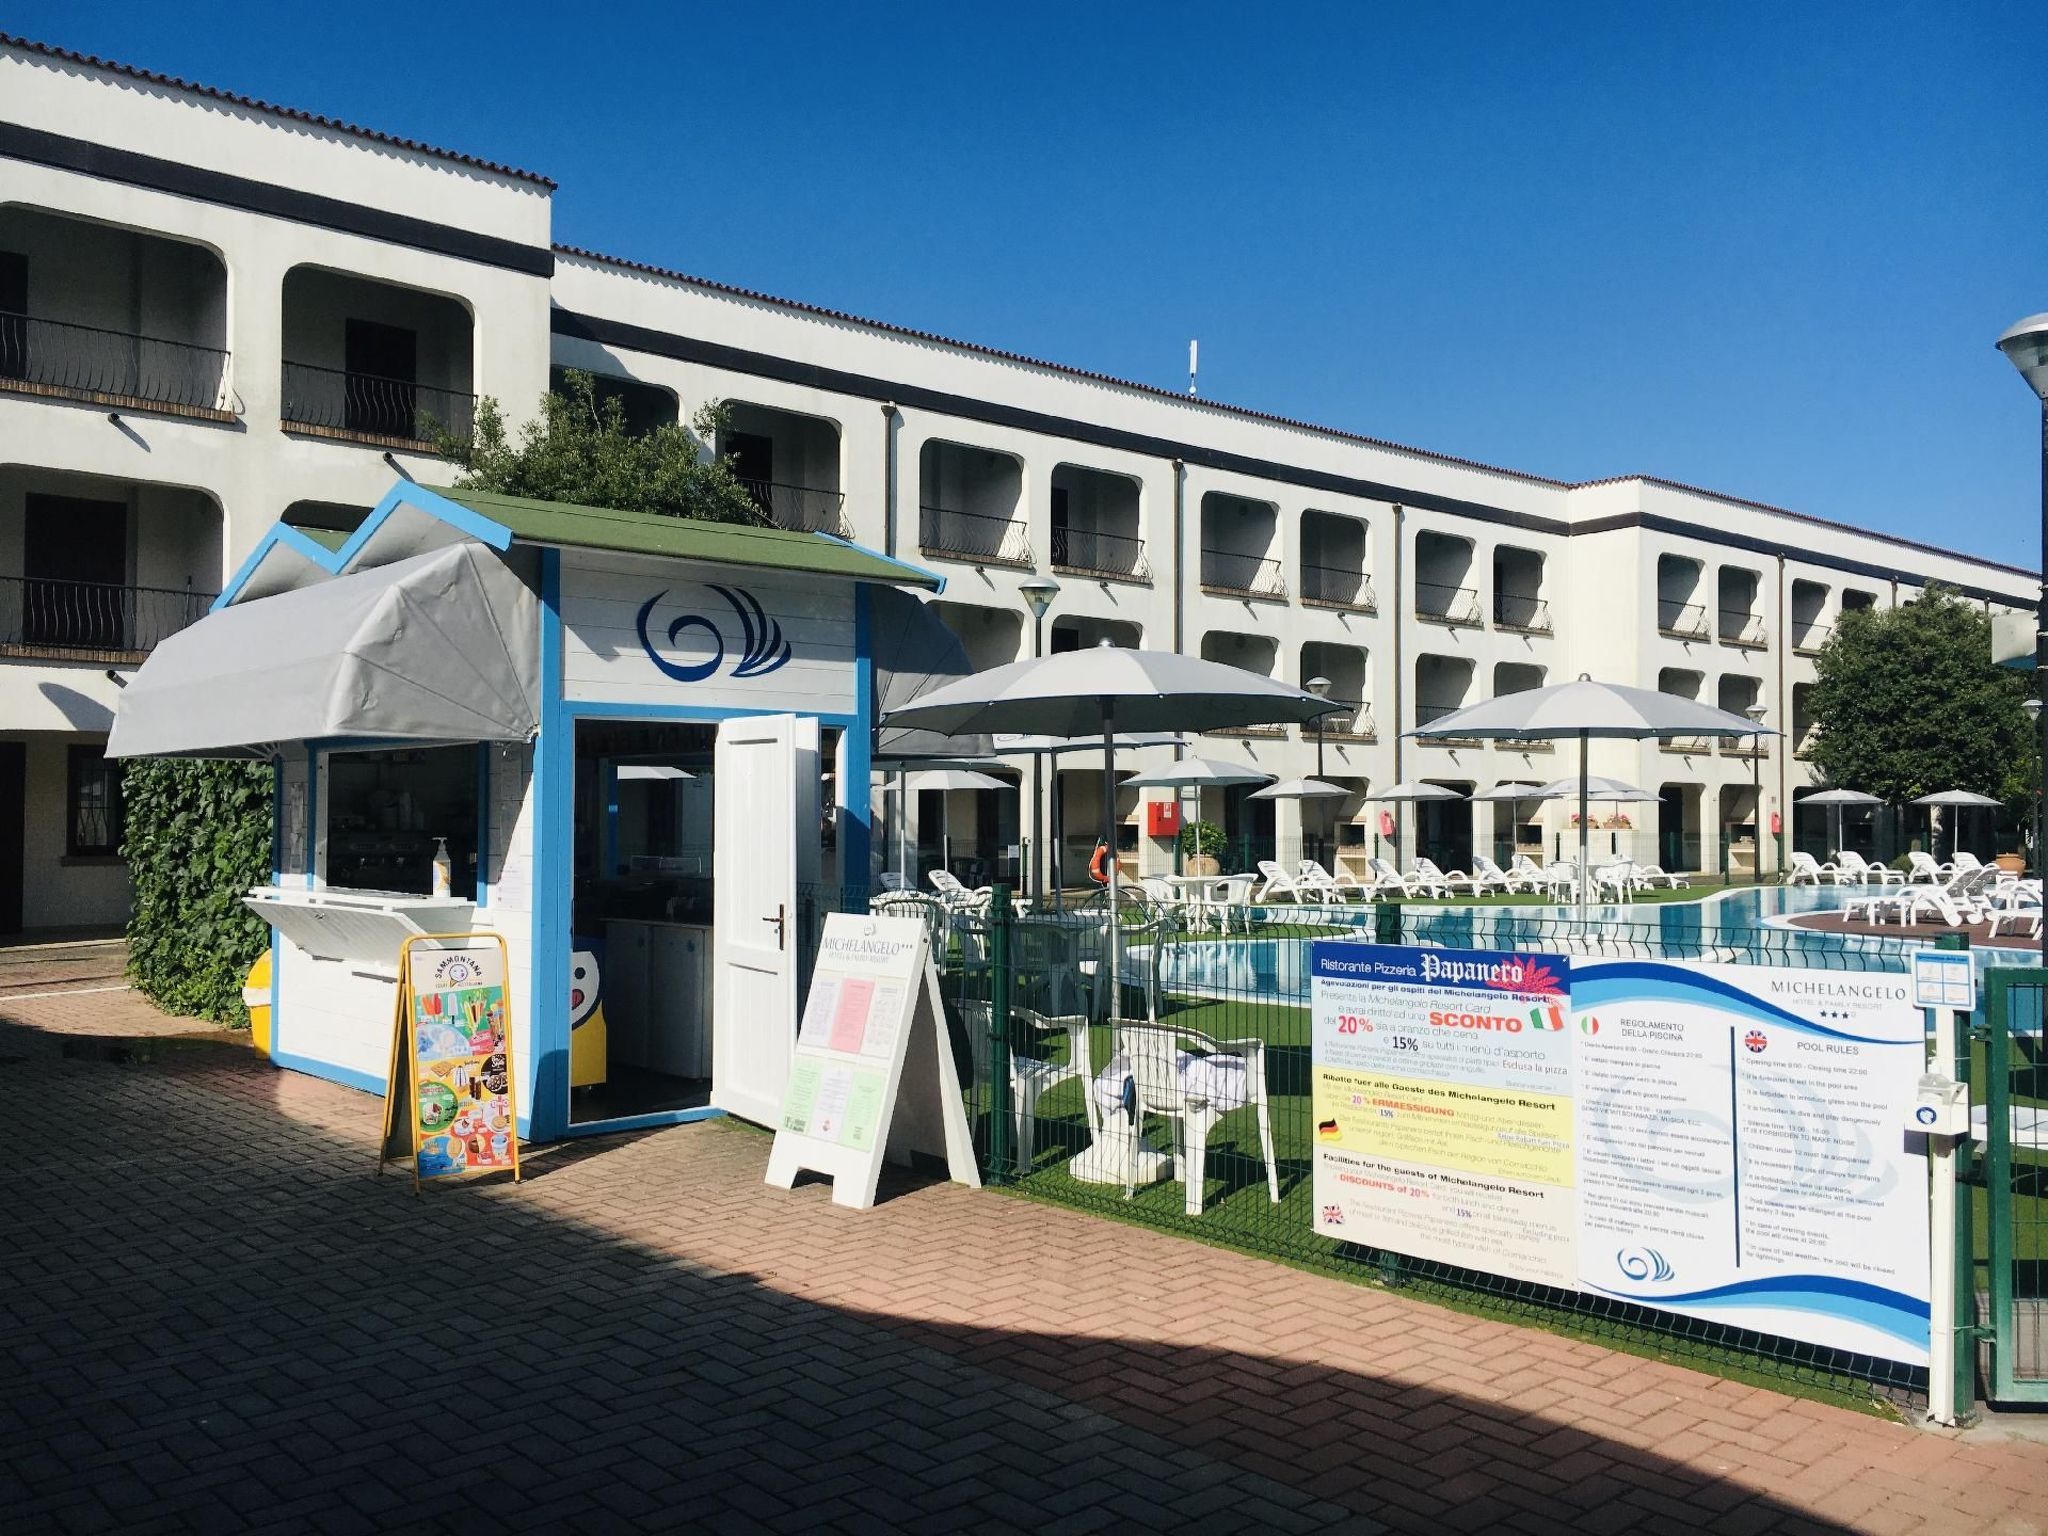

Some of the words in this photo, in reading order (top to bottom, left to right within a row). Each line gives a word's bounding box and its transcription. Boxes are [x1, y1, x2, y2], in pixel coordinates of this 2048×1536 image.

[822, 937, 900, 955] MICHELANGELO
[435, 955, 482, 979] SAMMONTANA
[1321, 958, 1371, 973] Ristorante
[1374, 962, 1417, 977] Pizzeria
[1420, 953, 1522, 983] Papanero
[1372, 983, 1386, 991] per
[1388, 984, 1398, 993] gli
[1400, 986, 1424, 994] ospiti
[1444, 989, 1508, 1000] Michelangelo
[1771, 980, 1906, 1000] MICHELANGELO
[1368, 994, 1428, 1009] Michelangelo
[1430, 1000, 1462, 1011] Resort
[1464, 1003, 1490, 1014] Card
[1338, 1015, 1373, 1034] 20%
[1398, 1025, 1430, 1036] pranzo
[1430, 1011, 1523, 1033] SCONTO
[1620, 1018, 1684, 1032] REGOLAMENTO
[1622, 1028, 1647, 1038] DELLA
[1650, 1031, 1683, 1042] PISCINA
[1393, 1036, 1418, 1052] 15%
[1422, 1041, 1434, 1049] su
[1436, 1040, 1454, 1051] tutti
[1494, 1047, 1545, 1060] d'asporto
[1797, 1041, 1824, 1052] POOL
[1826, 1044, 1859, 1056] RULES
[1503, 1060, 1532, 1072] Esclusa
[1536, 1063, 1542, 1072] la
[1545, 1066, 1568, 1076] pizza
[1746, 1058, 1772, 1068] Opening
[1808, 1064, 1832, 1074] Closing
[1833, 1066, 1847, 1074] time
[1828, 1082, 1842, 1090] pool
[1374, 1081, 1389, 1089] alle
[1392, 1083, 1425, 1094] Gaeste
[1428, 1088, 1446, 1097] des
[1448, 1090, 1516, 1105] Michelangelo
[1518, 1099, 1555, 1110] Resort
[1372, 1098, 1454, 1116] ERMAESSIGUNG
[1380, 1108, 1394, 1118] 15%
[1873, 1103, 1888, 1111] pool
[1323, 1153, 1360, 1166] Facilities
[1362, 1160, 1375, 1169] for
[1377, 1163, 1391, 1172] the
[1394, 1167, 1425, 1179] guests
[1440, 1175, 1506, 1192] Michelangelo
[1508, 1186, 1544, 1199] Resort
[1340, 1173, 1394, 1191] DISCOUNTS
[1397, 1186, 1407, 1194] of
[1410, 1187, 1430, 1198] 20%
[1457, 1208, 1472, 1218] 15%
